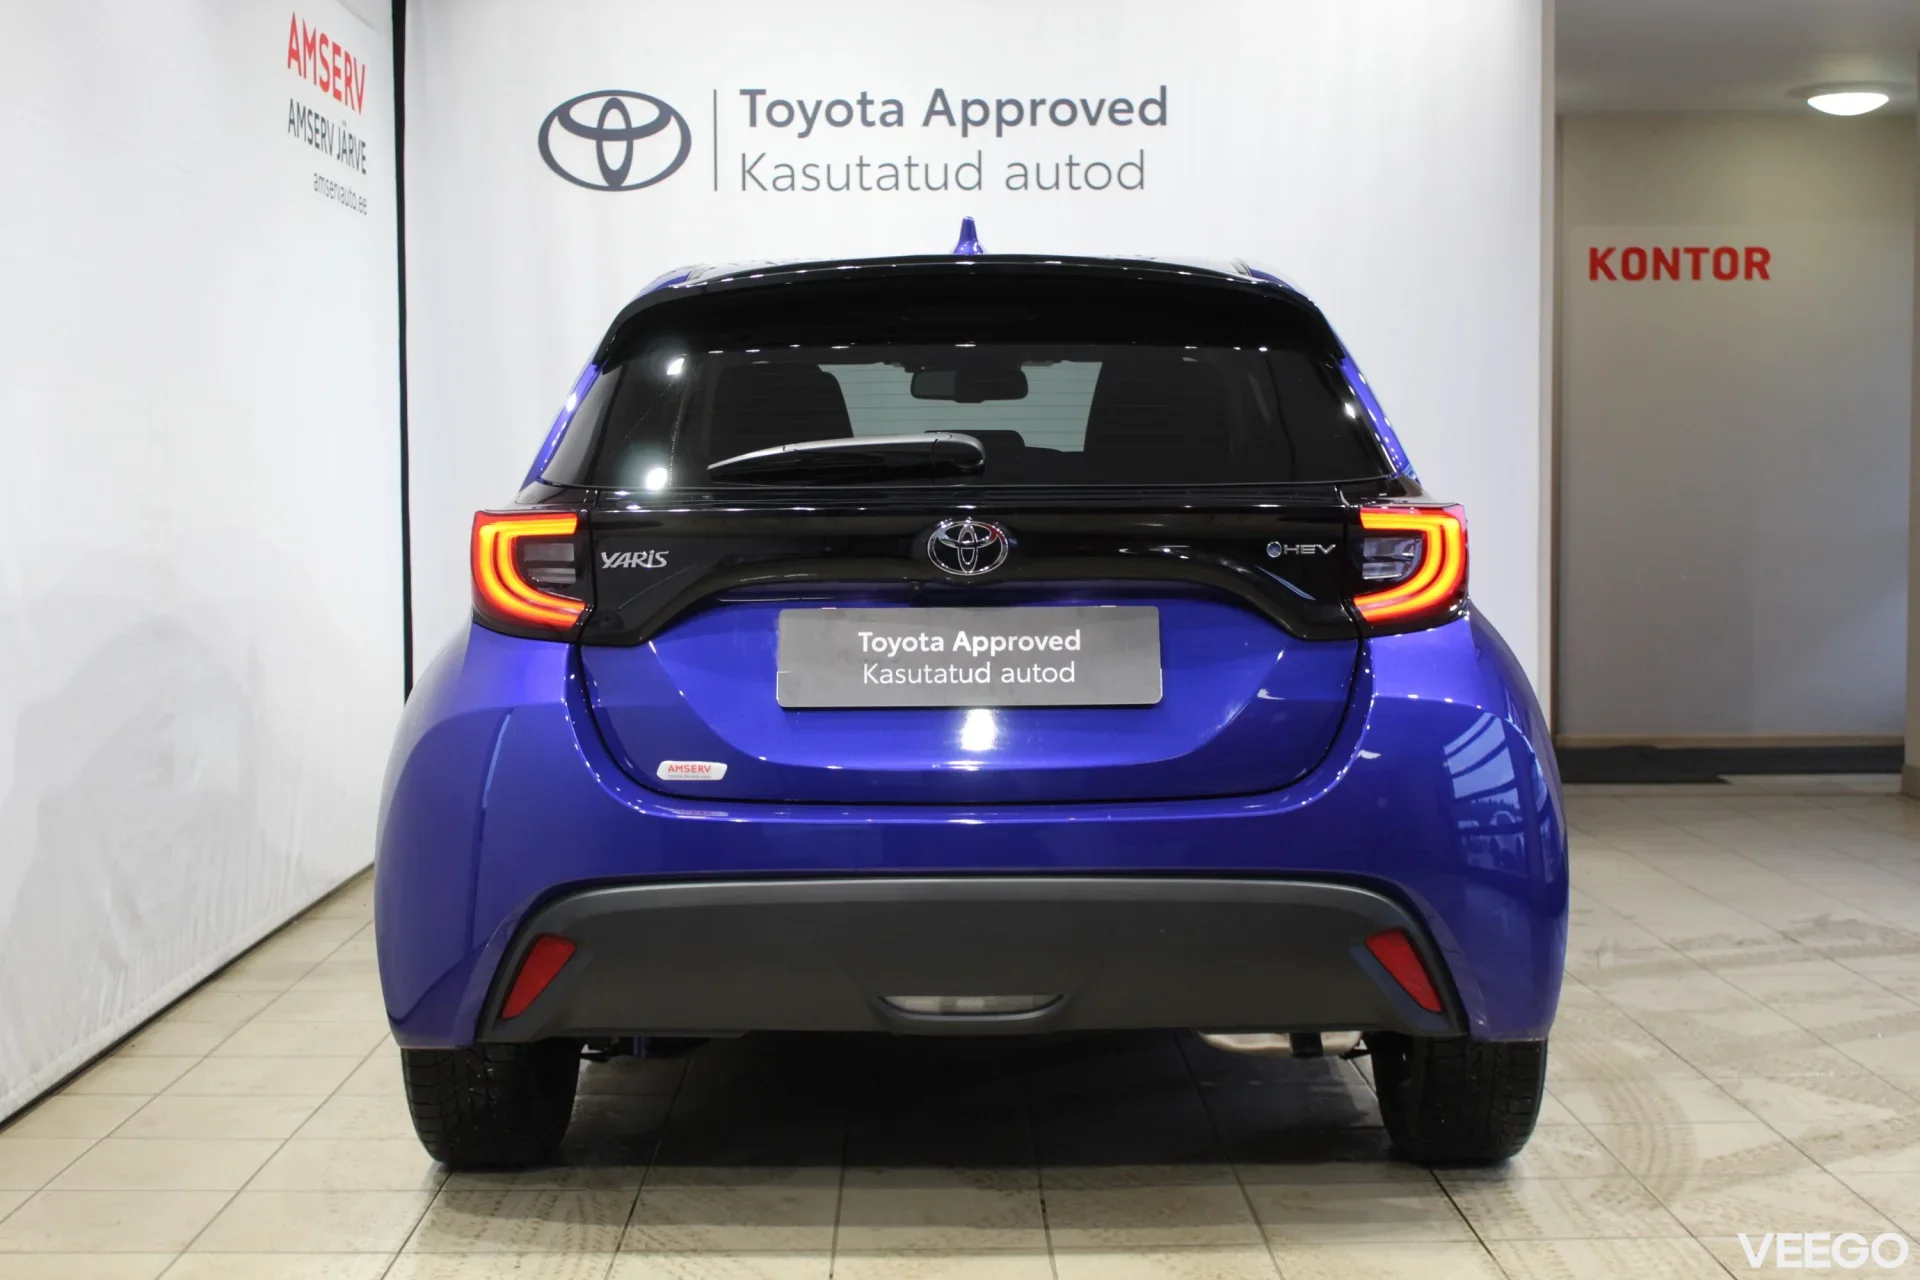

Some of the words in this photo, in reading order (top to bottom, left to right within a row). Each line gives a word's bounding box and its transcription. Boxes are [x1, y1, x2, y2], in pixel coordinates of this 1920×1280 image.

[287, 11, 366, 115] AMSERV
[739, 87, 905, 138] Toyota
[921, 85, 1168, 138] Approved
[287, 98, 335, 156] AMSERV
[336, 120, 367, 175] JÄRVE
[740, 149, 984, 191] Kasutatud
[1004, 149, 1145, 191] autod
[313, 173, 368, 216] amservauto.ee
[1588, 246, 1771, 281] KONTOR
[1283, 544, 1336, 555] HEV
[858, 631, 944, 657] Toyota
[952, 629, 1081, 657] Approved
[863, 662, 991, 684] Kasutatud
[1000, 661, 1076, 683] autod
[667, 764, 712, 773] AMSERV
